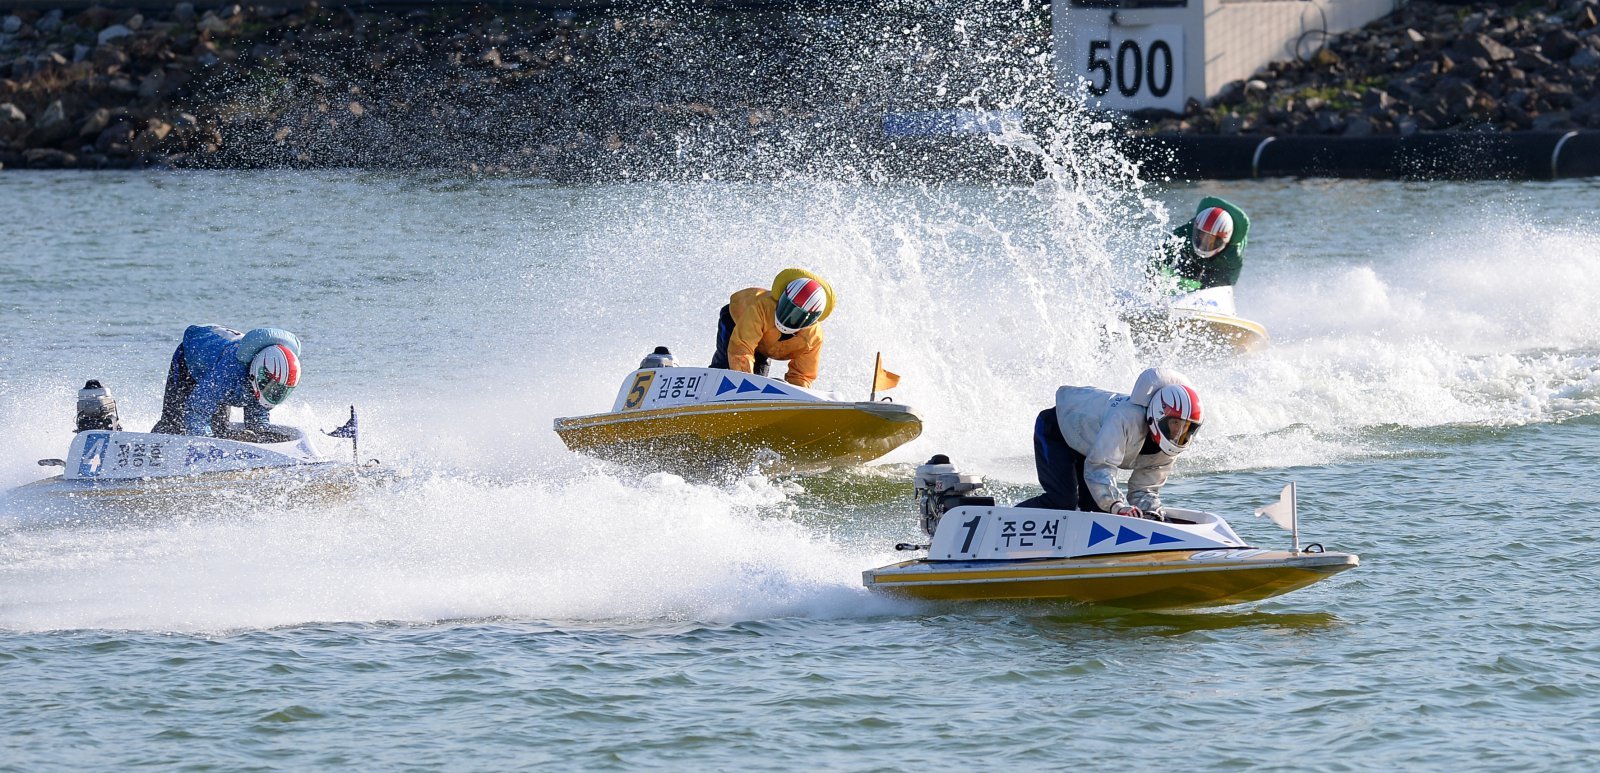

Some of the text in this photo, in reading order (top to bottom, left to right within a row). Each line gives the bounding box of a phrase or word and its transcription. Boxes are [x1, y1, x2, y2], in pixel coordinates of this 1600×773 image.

[1086, 39, 1173, 97] 500
[626, 375, 701, 408] 5 김종민
[82, 438, 105, 472] 4
[960, 516, 1060, 553] 1 주은석
